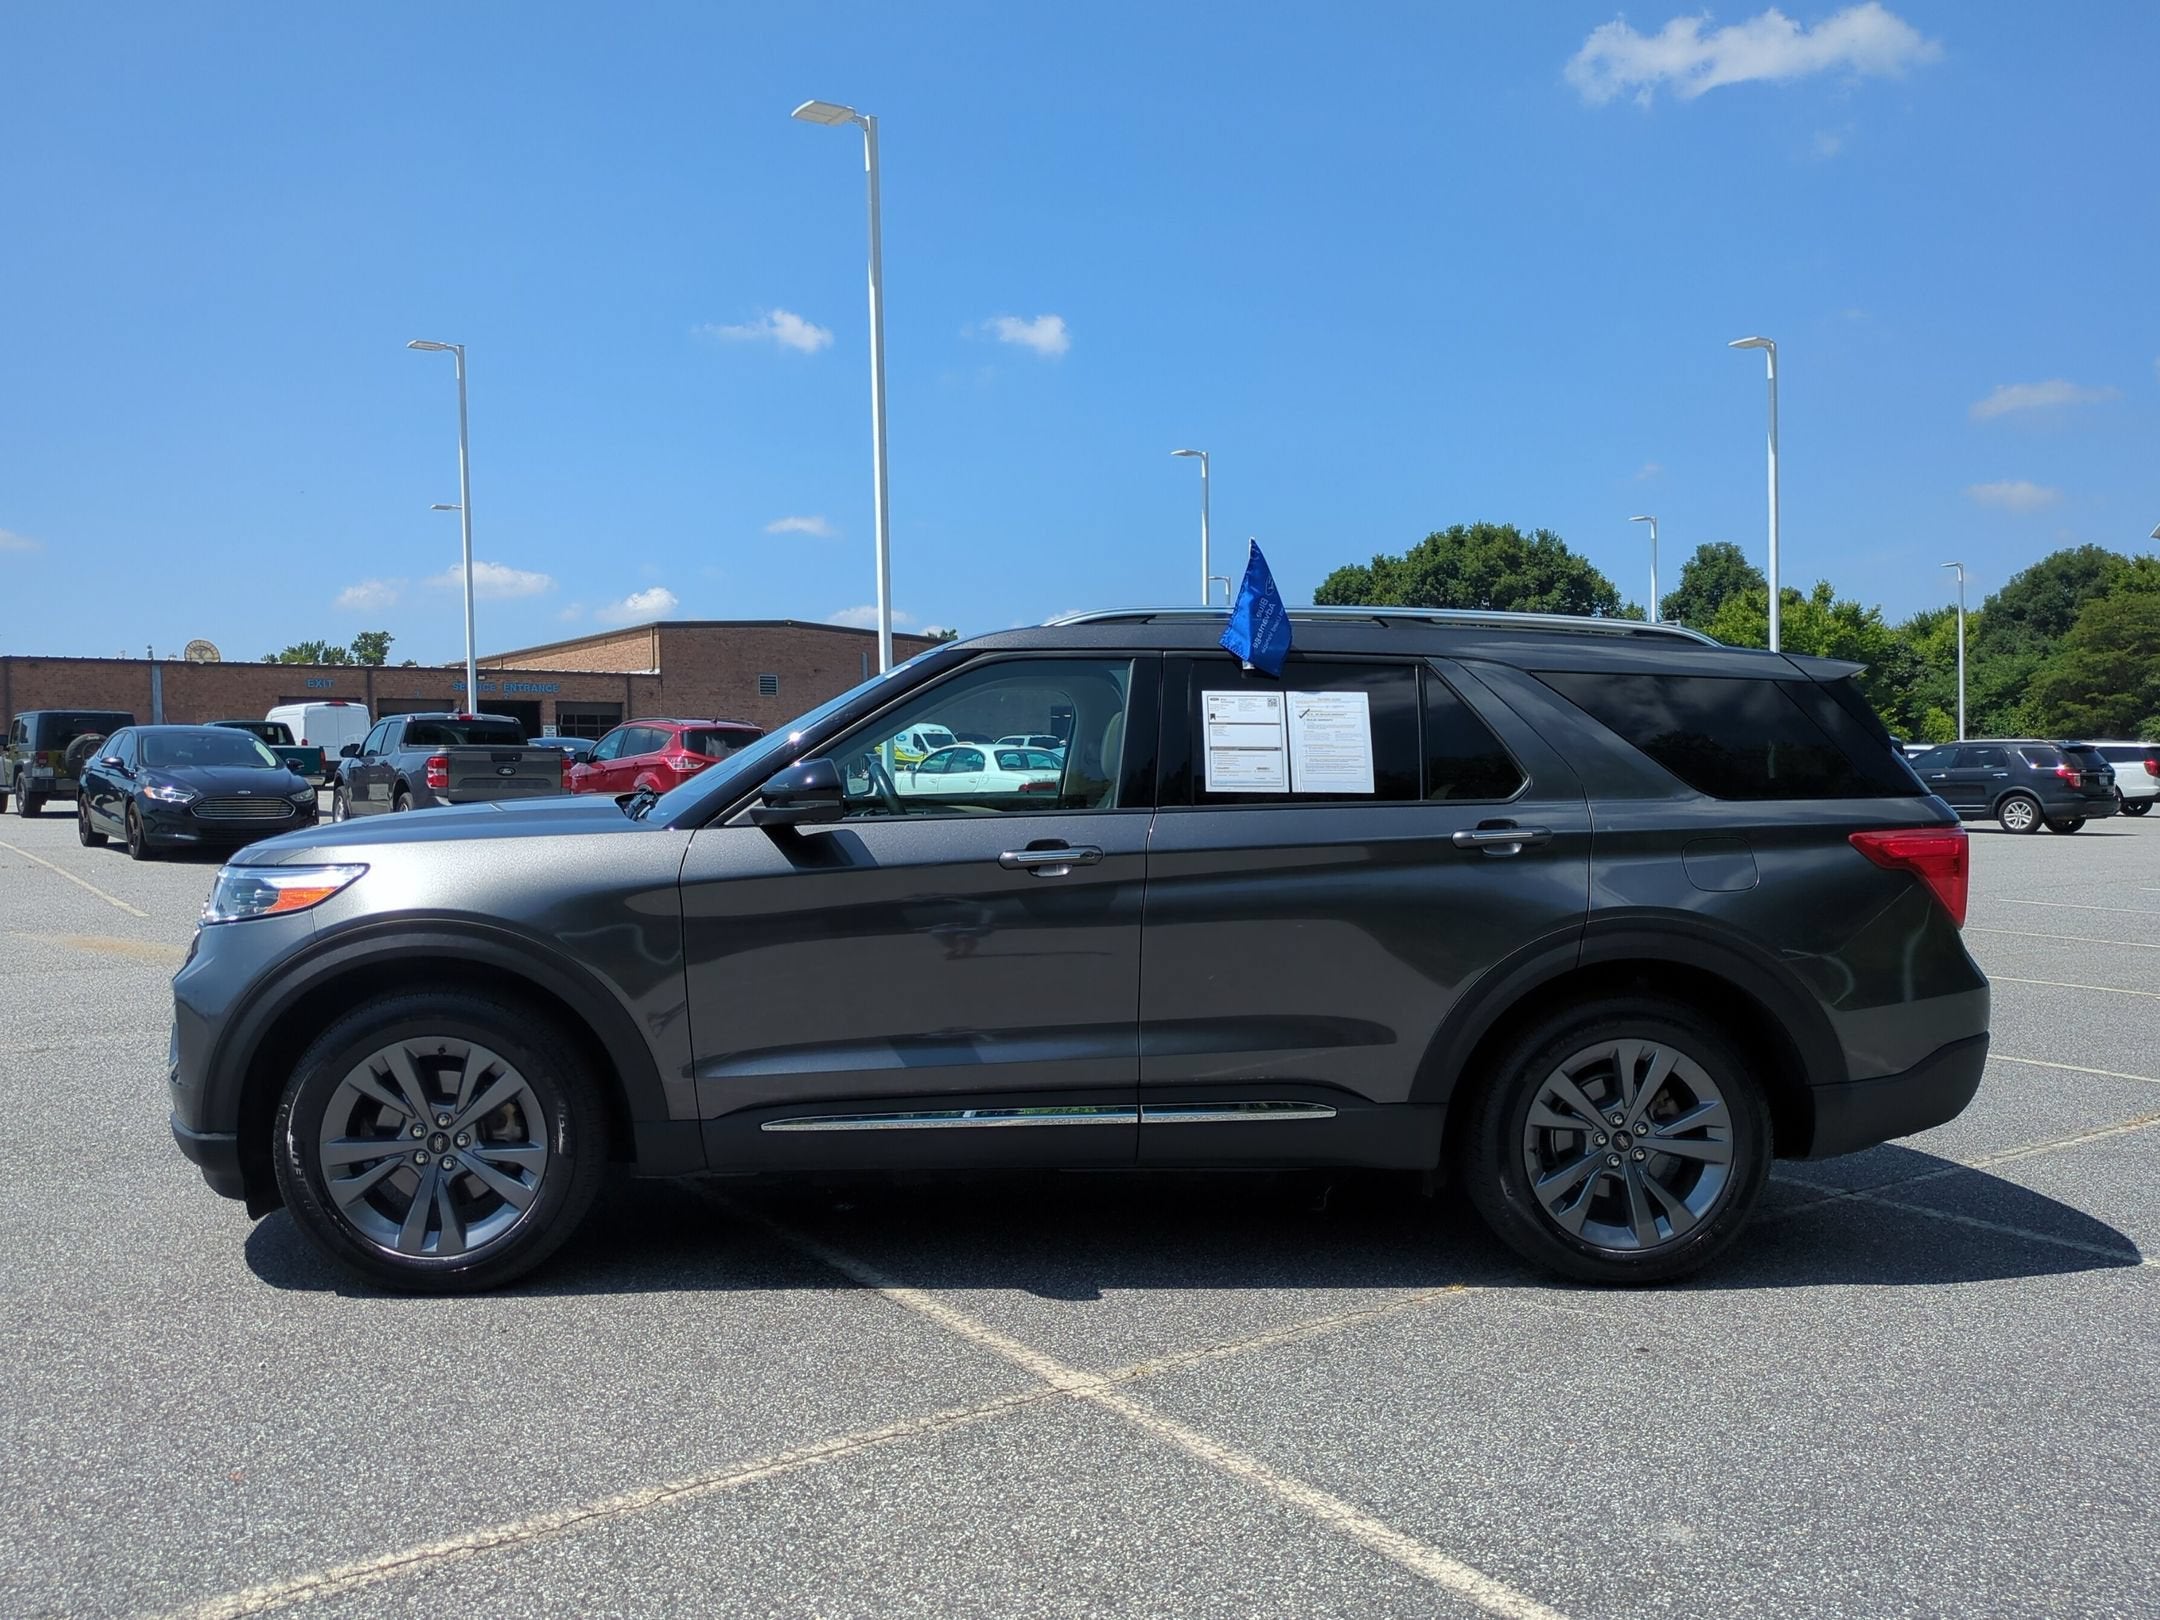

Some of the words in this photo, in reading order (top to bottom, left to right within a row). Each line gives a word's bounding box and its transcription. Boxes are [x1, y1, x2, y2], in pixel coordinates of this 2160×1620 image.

[306, 678, 334, 688] EXIT
[452, 681, 497, 692] SEICE
[503, 682, 560, 693] ENTRANCE
